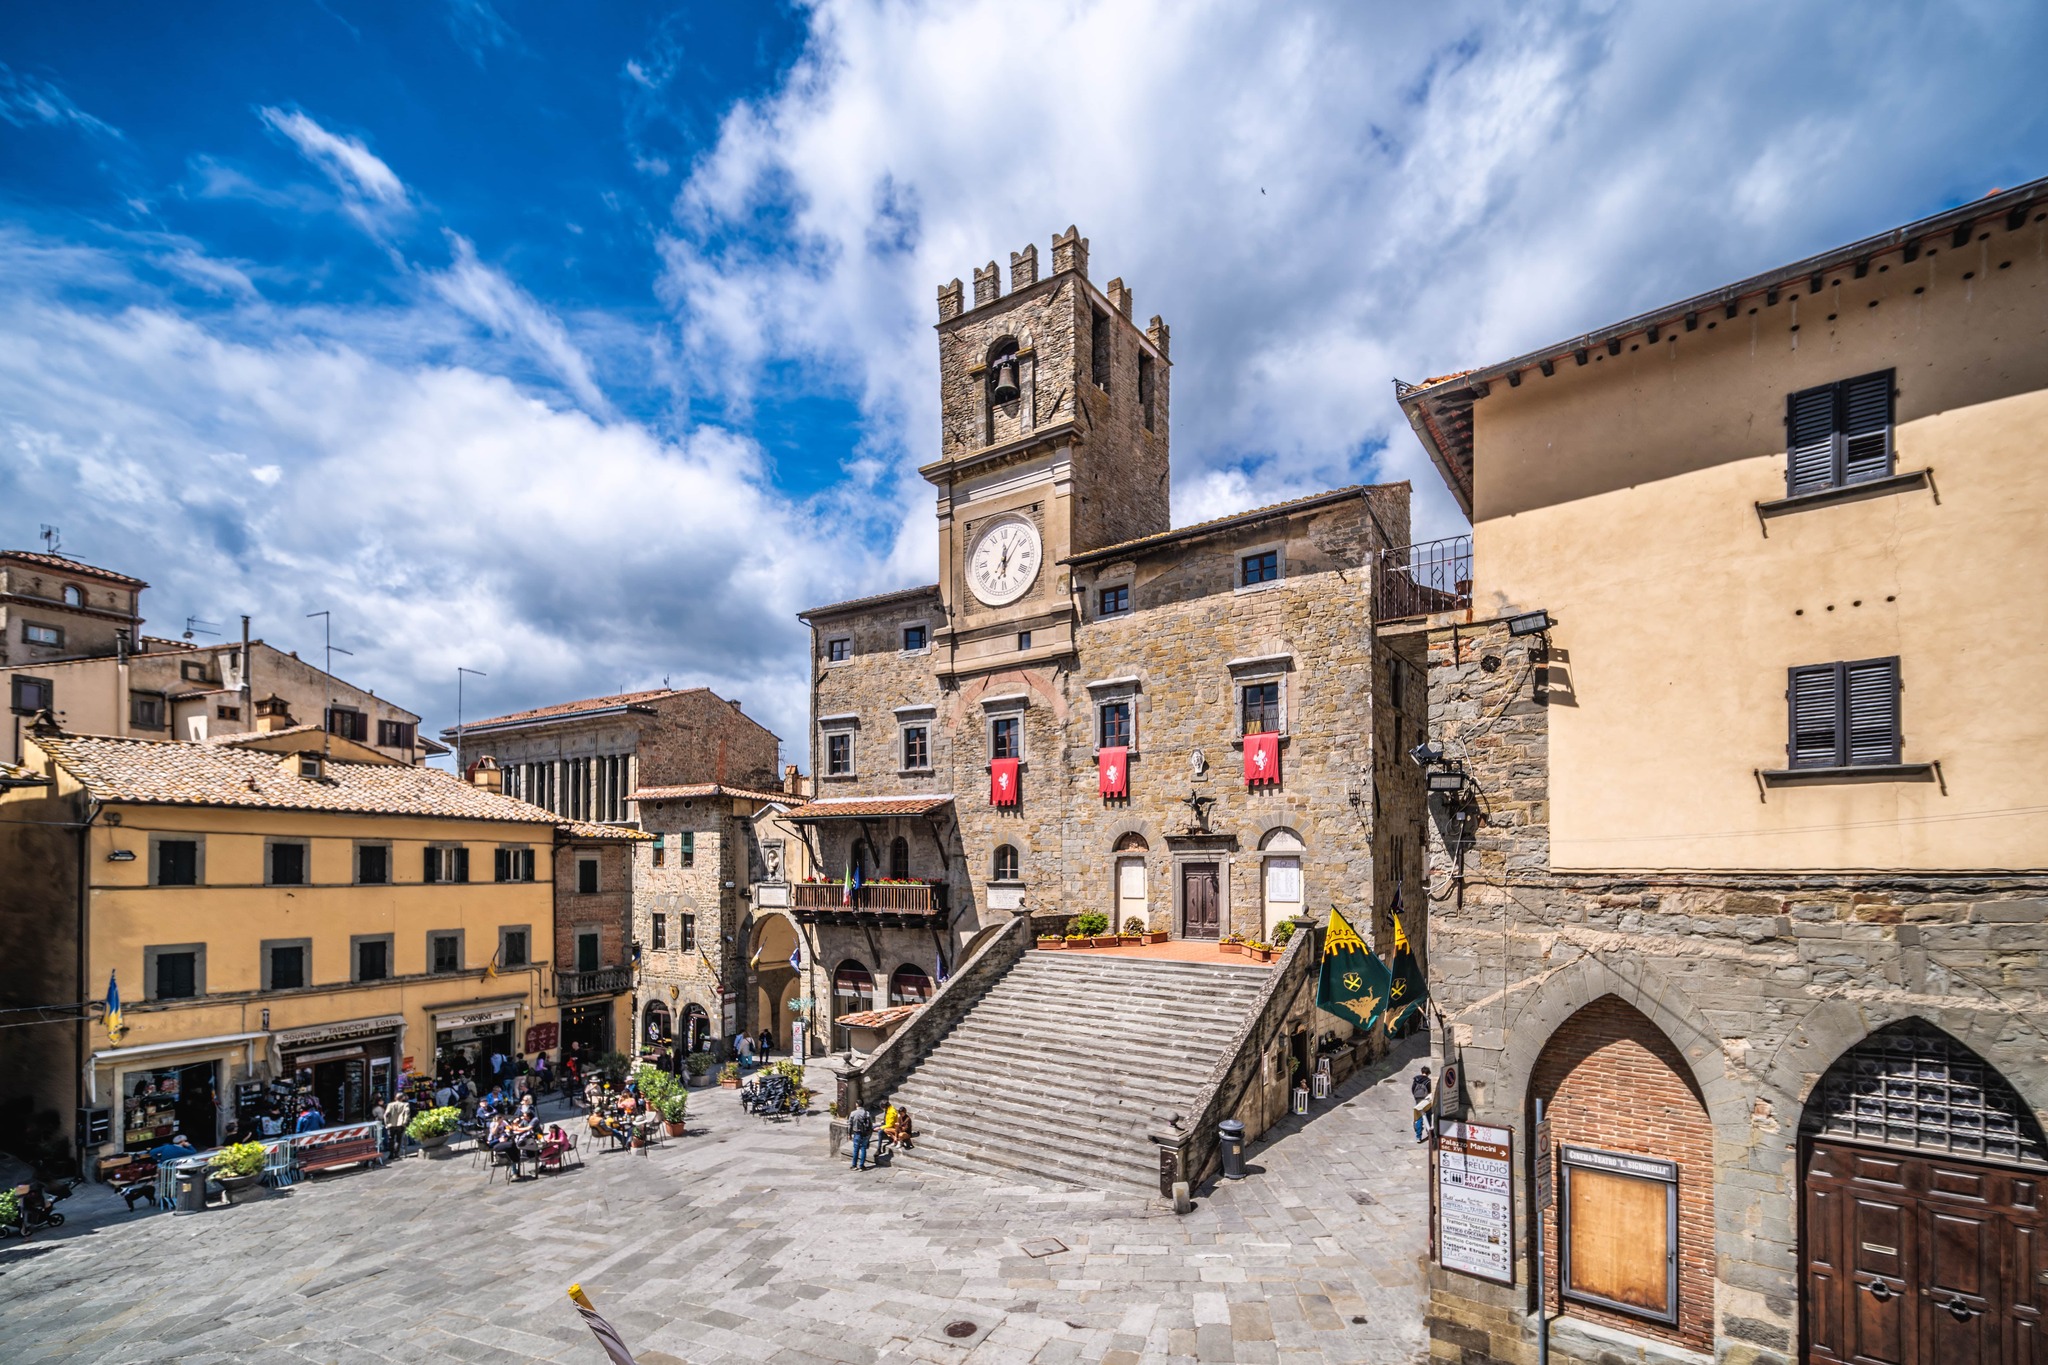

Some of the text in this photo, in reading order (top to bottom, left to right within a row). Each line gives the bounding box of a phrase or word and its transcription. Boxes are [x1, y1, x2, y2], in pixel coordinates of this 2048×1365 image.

[282, 1030, 322, 1041] Souvenir
[328, 1022, 370, 1034] TABACCHI
[375, 1019, 398, 1027] Lotto
[1441, 1138, 1497, 1153] Palazzo Mancini
[1569, 1150, 1616, 1166] CINEMA-TEATRO
[1464, 1160, 1508, 1175] PRELUDIO
[1465, 1173, 1508, 1189] ENOTECA
